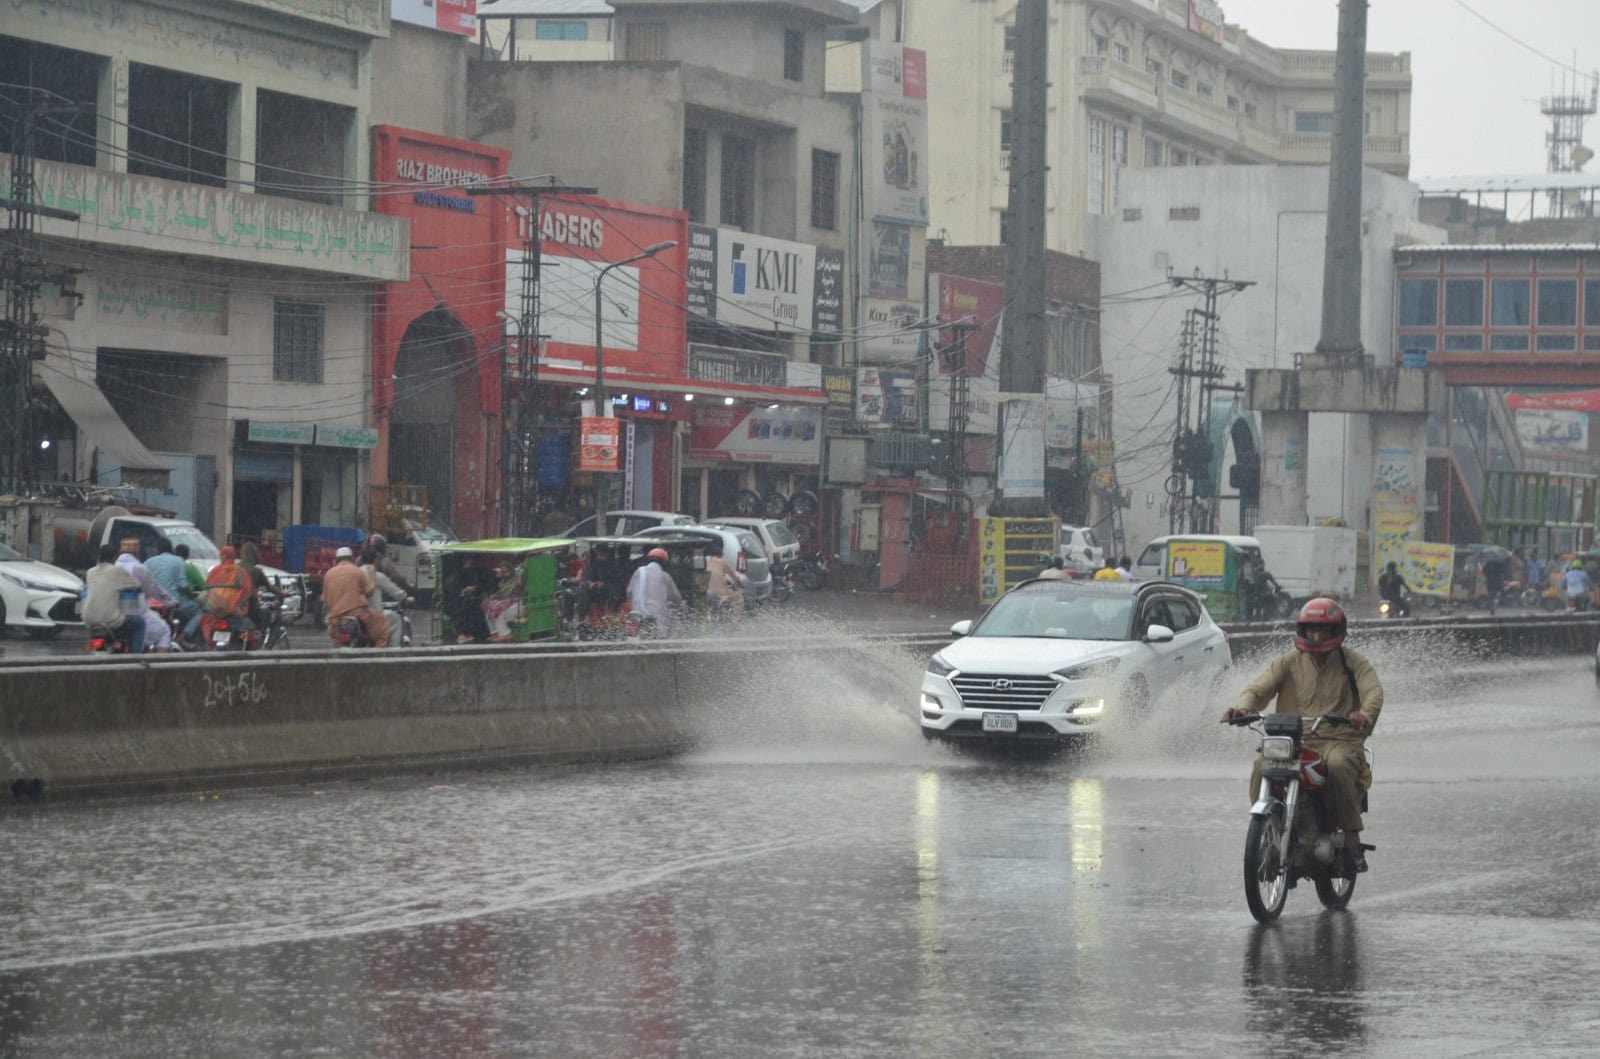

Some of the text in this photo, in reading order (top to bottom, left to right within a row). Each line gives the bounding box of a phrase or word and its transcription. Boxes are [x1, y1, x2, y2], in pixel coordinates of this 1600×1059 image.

[397, 158, 424, 181] RIAZ
[755, 247, 798, 294] KMI
[773, 296, 799, 327] Group
